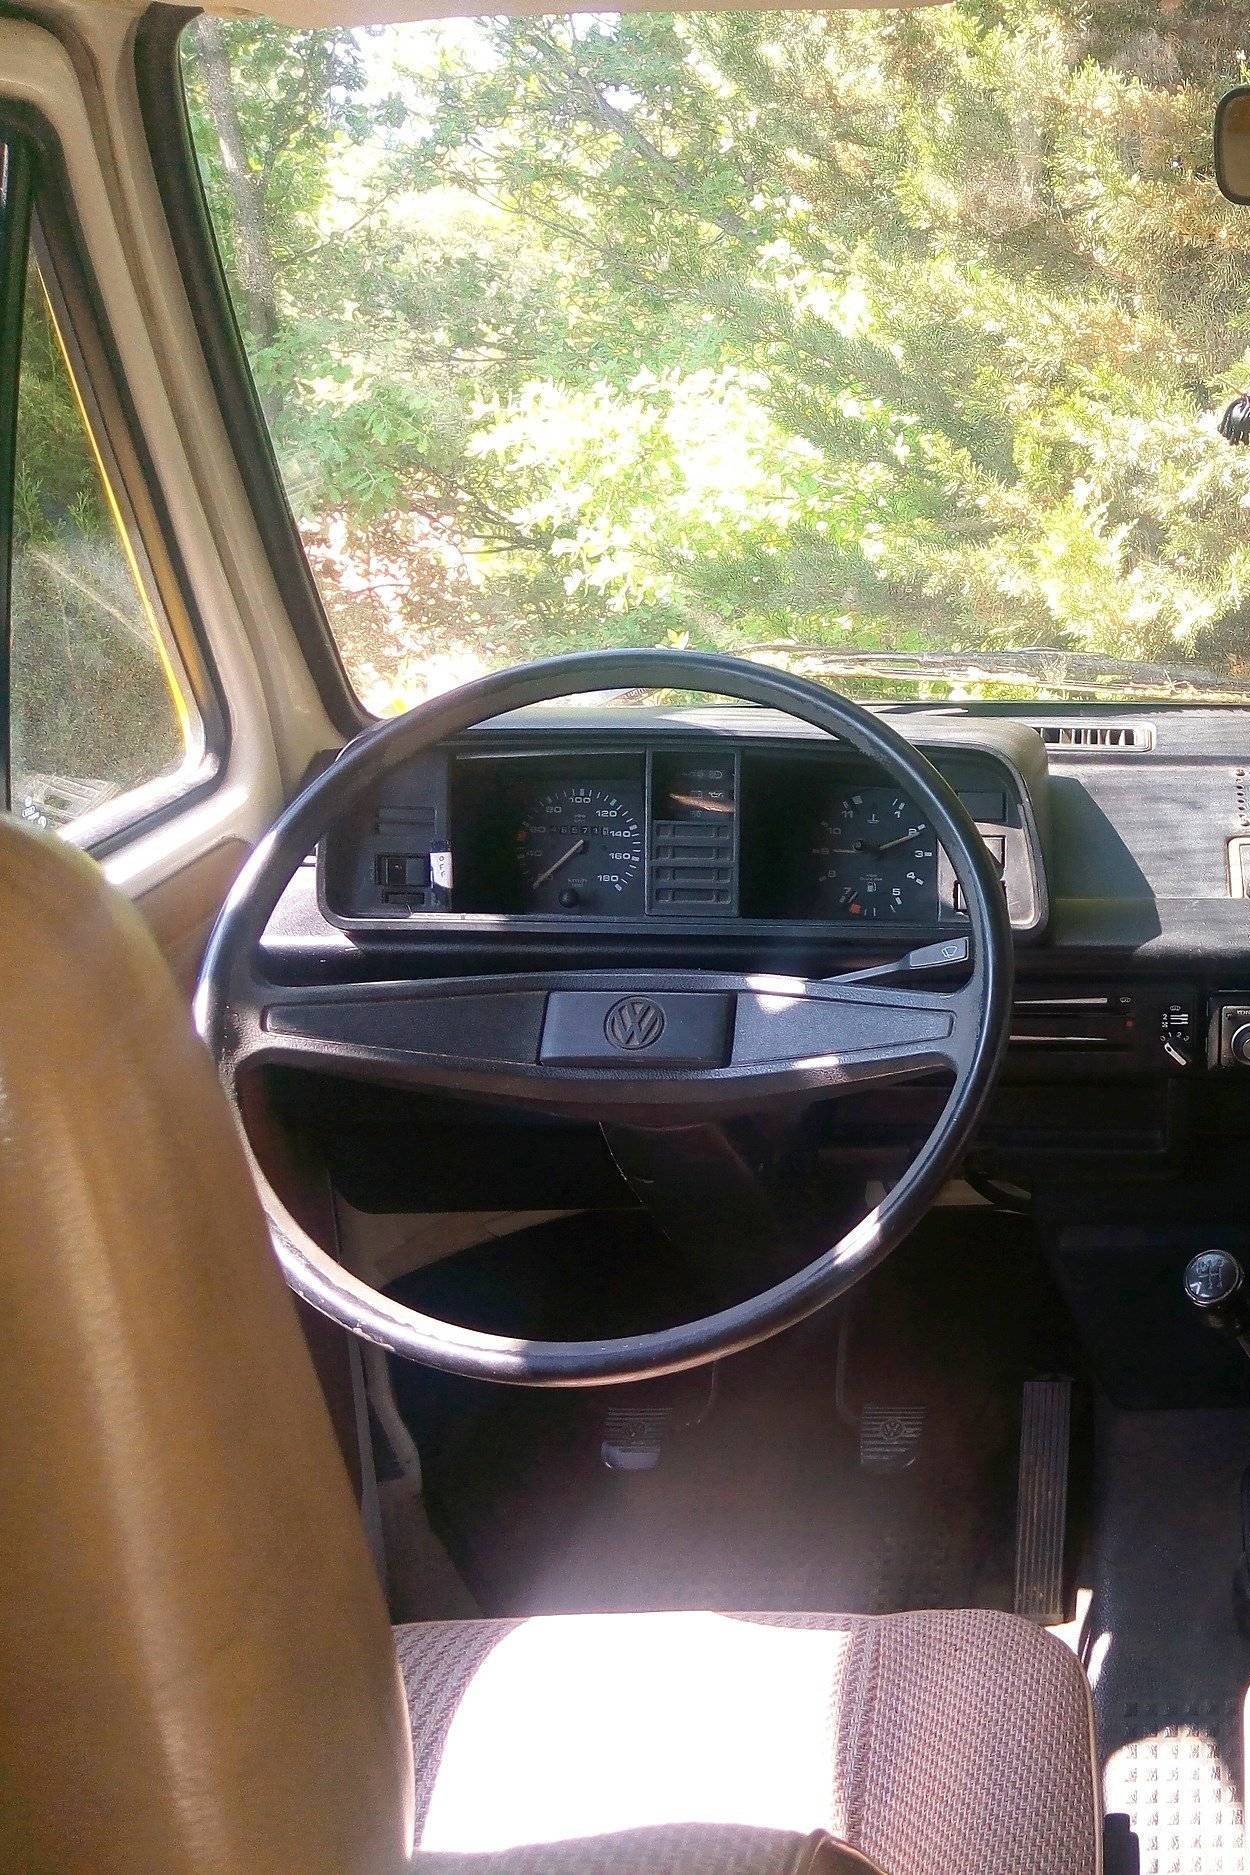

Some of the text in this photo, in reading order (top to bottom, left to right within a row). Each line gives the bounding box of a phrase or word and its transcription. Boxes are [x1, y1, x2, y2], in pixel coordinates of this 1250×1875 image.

[569, 796, 592, 804] 100
[595, 809, 618, 817] 120
[841, 809, 854, 818] 11
[610, 830, 631, 838] 140
[827, 827, 841, 835] 10
[609, 852, 631, 860] 160
[914, 850, 924, 858] 3
[597, 874, 619, 882] 180
[906, 871, 916, 880] 4
[892, 887, 901, 896] 5
[601, 991, 636, 1023] VW
